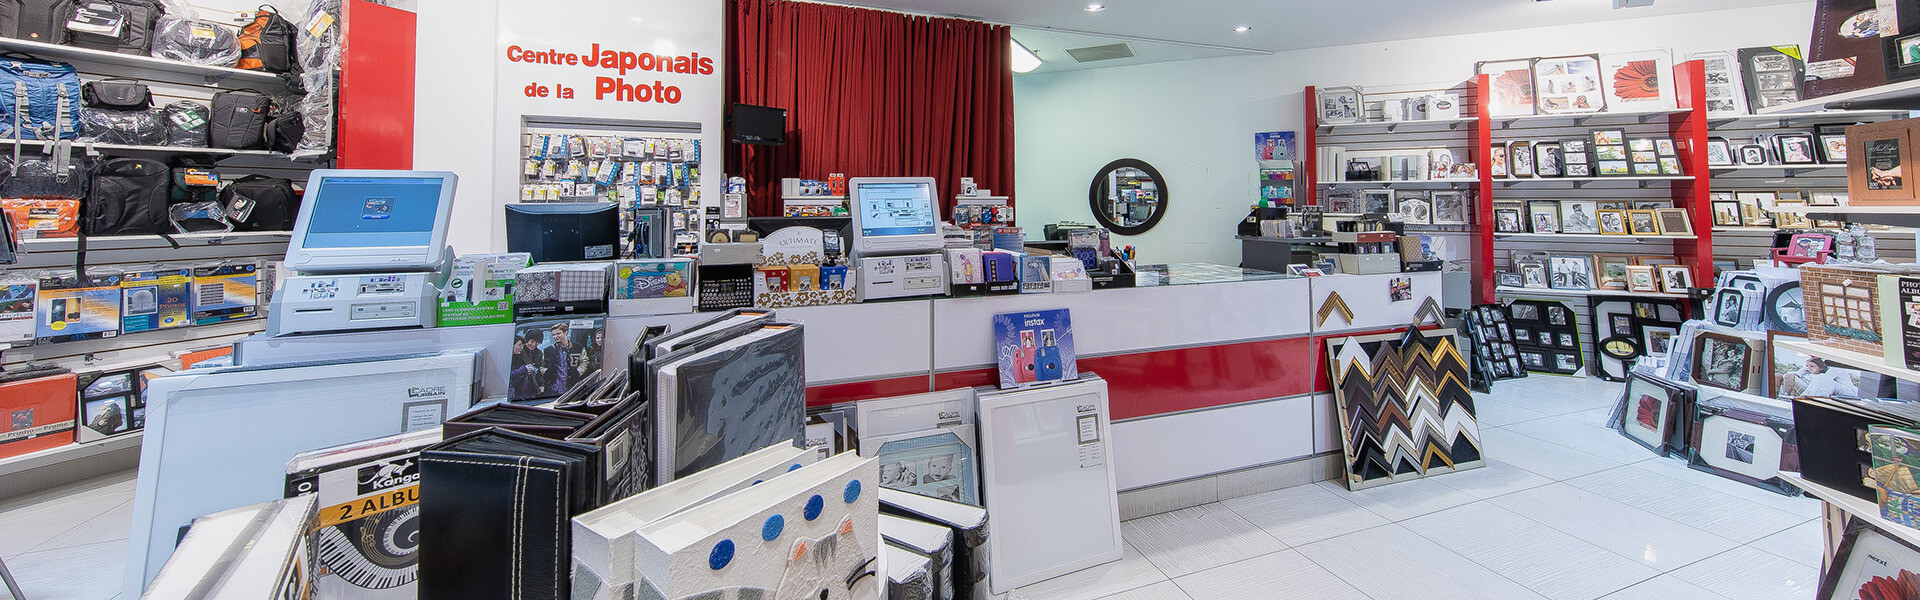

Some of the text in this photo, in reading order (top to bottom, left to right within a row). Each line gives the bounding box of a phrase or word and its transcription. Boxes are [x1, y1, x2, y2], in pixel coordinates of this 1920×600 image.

[507, 43, 714, 75] Centre Japonais
[524, 76, 682, 104] de la Photo
[779, 237, 819, 247] ULTIMATE
[1024, 319, 1045, 327] instax
[7, 422, 69, 438] Promo Promo
[339, 504, 353, 520] 2
